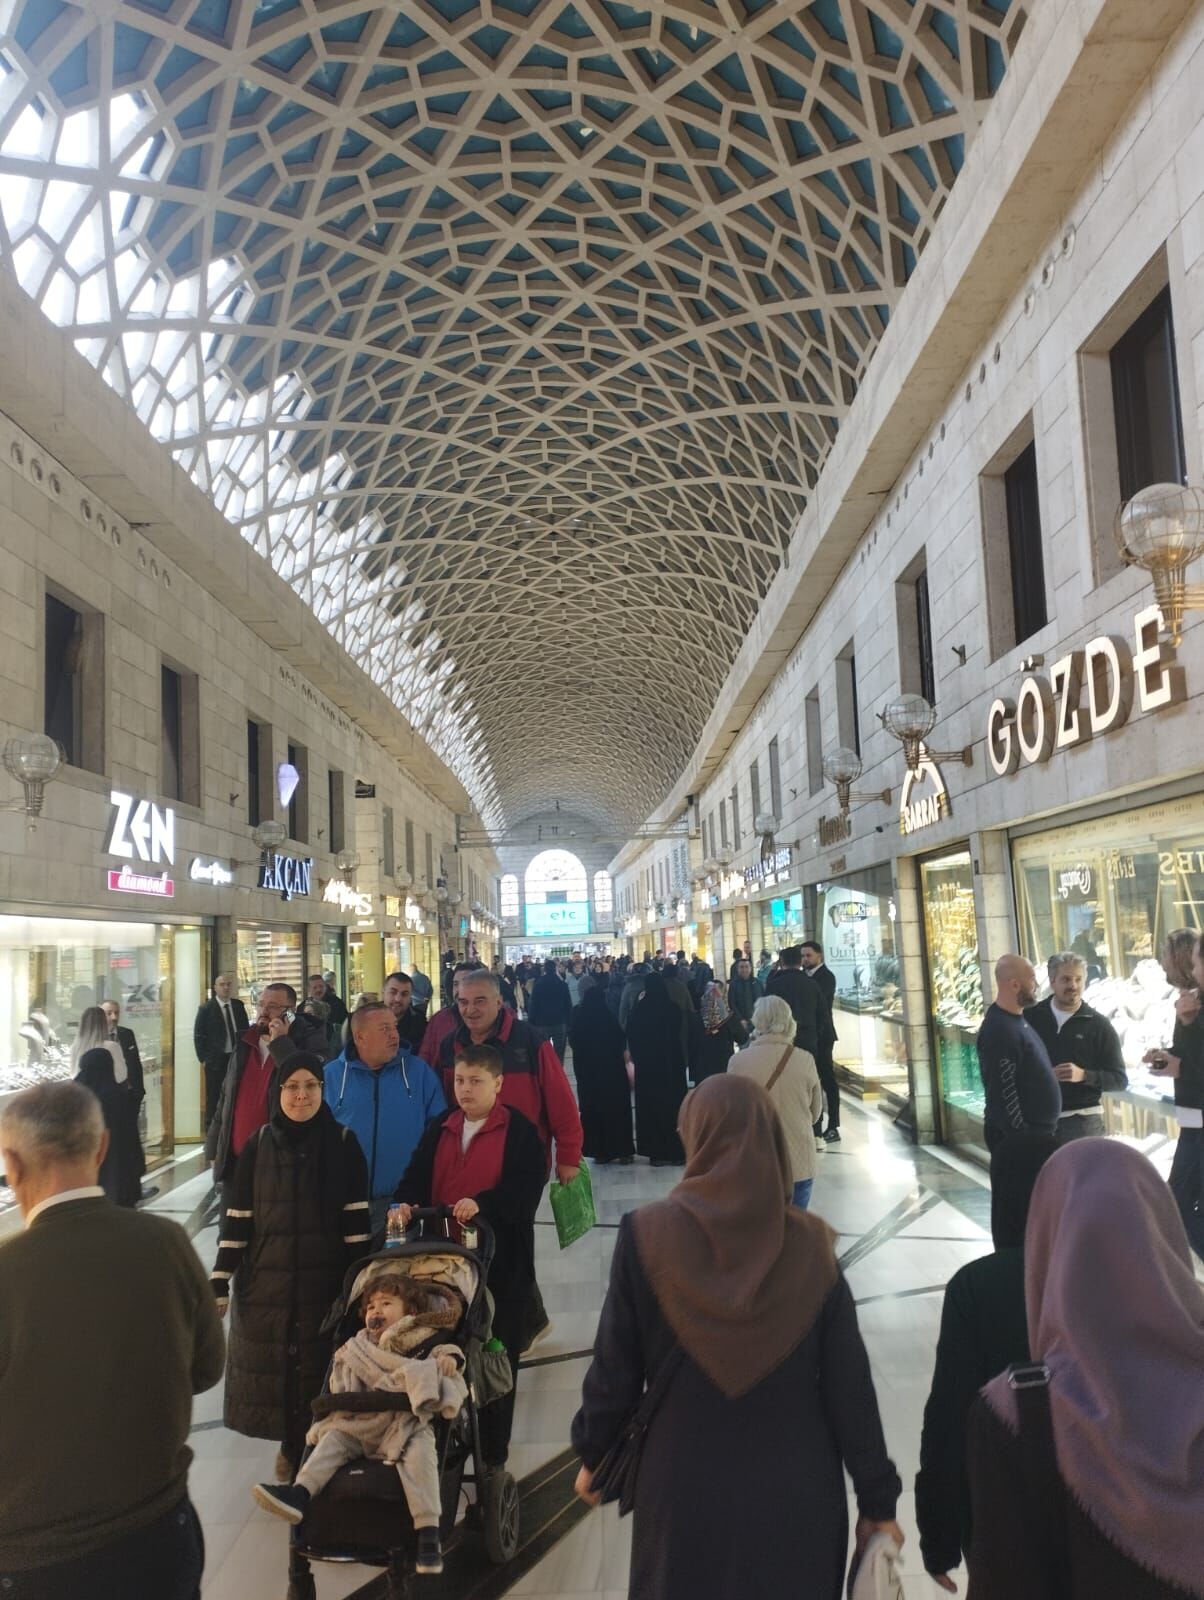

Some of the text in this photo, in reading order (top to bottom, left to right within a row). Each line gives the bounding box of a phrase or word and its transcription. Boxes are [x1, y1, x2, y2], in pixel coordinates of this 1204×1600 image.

[987, 605, 1175, 776] GÖZDE
[108, 791, 174, 865] ZEN
[904, 791, 941, 834] SARRAF
[117, 865, 168, 894] diamond
[262, 850, 311, 901] AKÇAN
